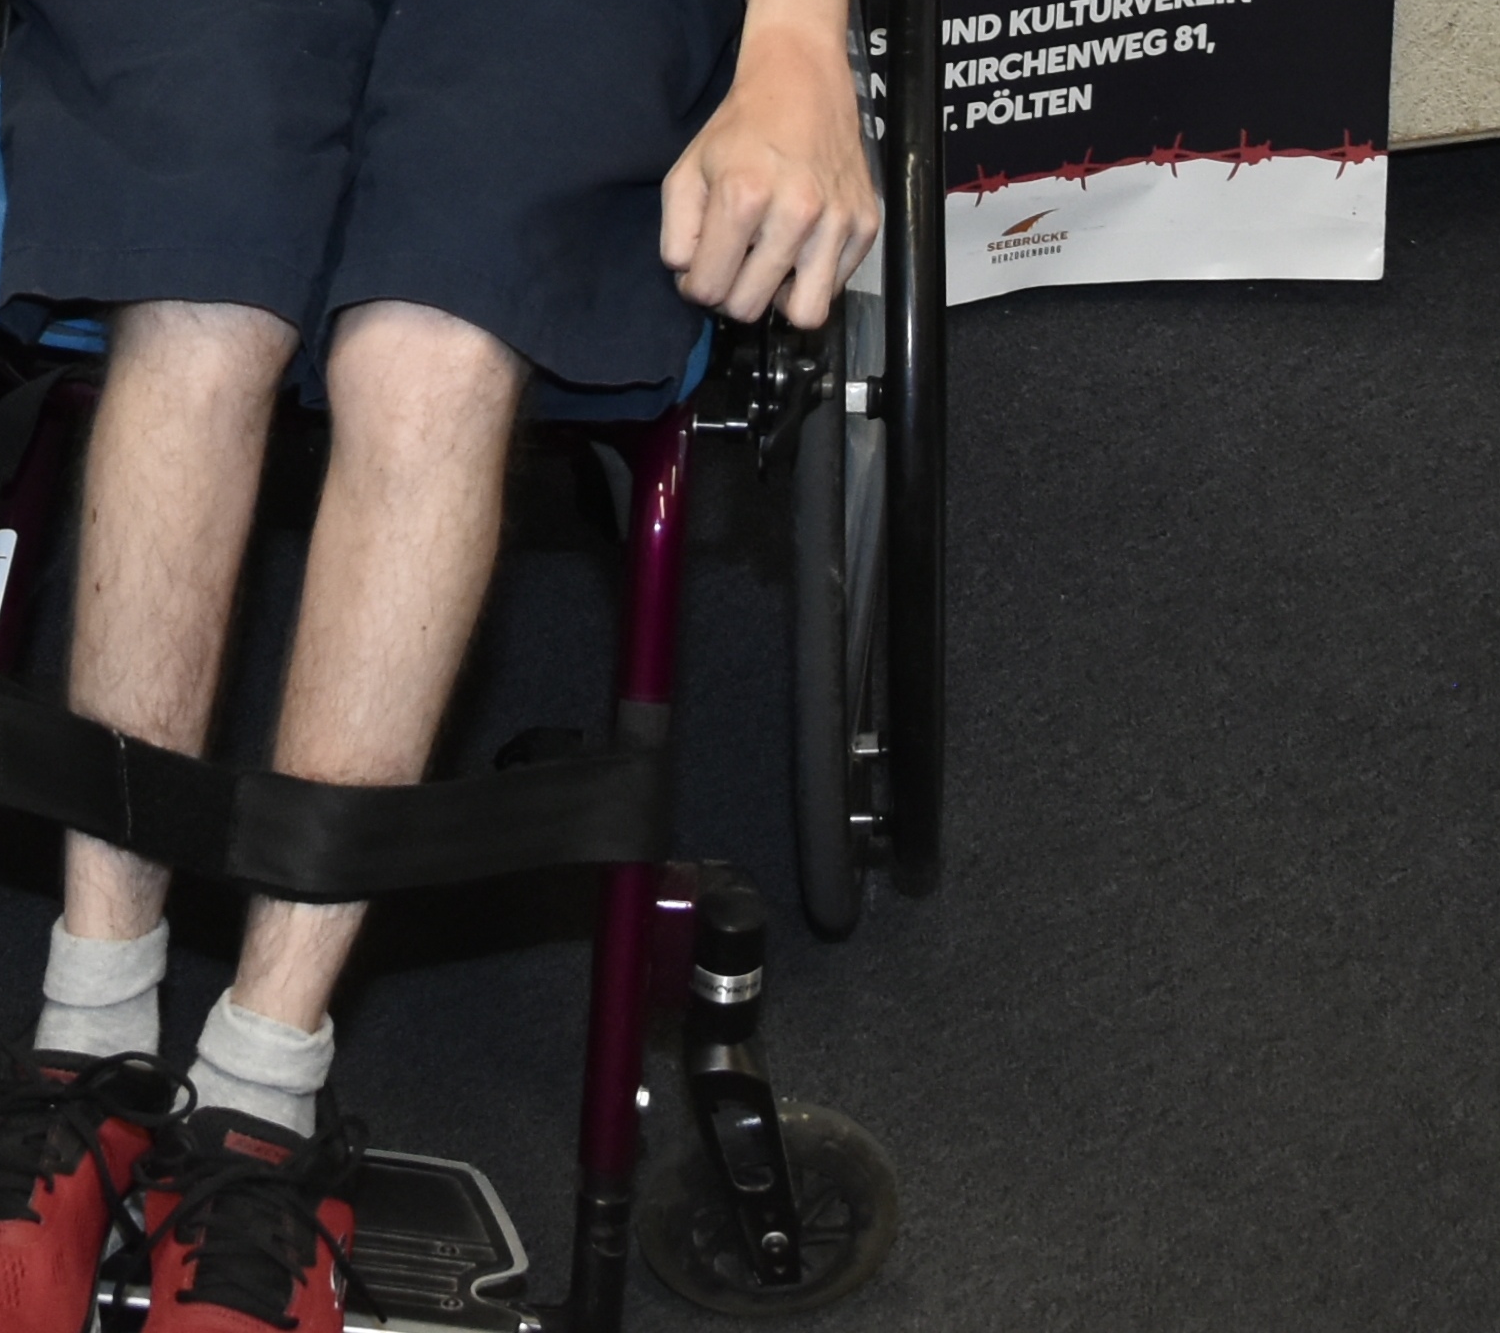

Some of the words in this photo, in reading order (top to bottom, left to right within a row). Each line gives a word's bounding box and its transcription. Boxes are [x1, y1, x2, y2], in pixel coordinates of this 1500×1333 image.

[943, 27, 1168, 91] KIRCHENWEG
[1173, 21, 1217, 55] 81,
[964, 82, 1093, 131] PÖLTEN
[986, 230, 1069, 252] SEEBRÜCKE
